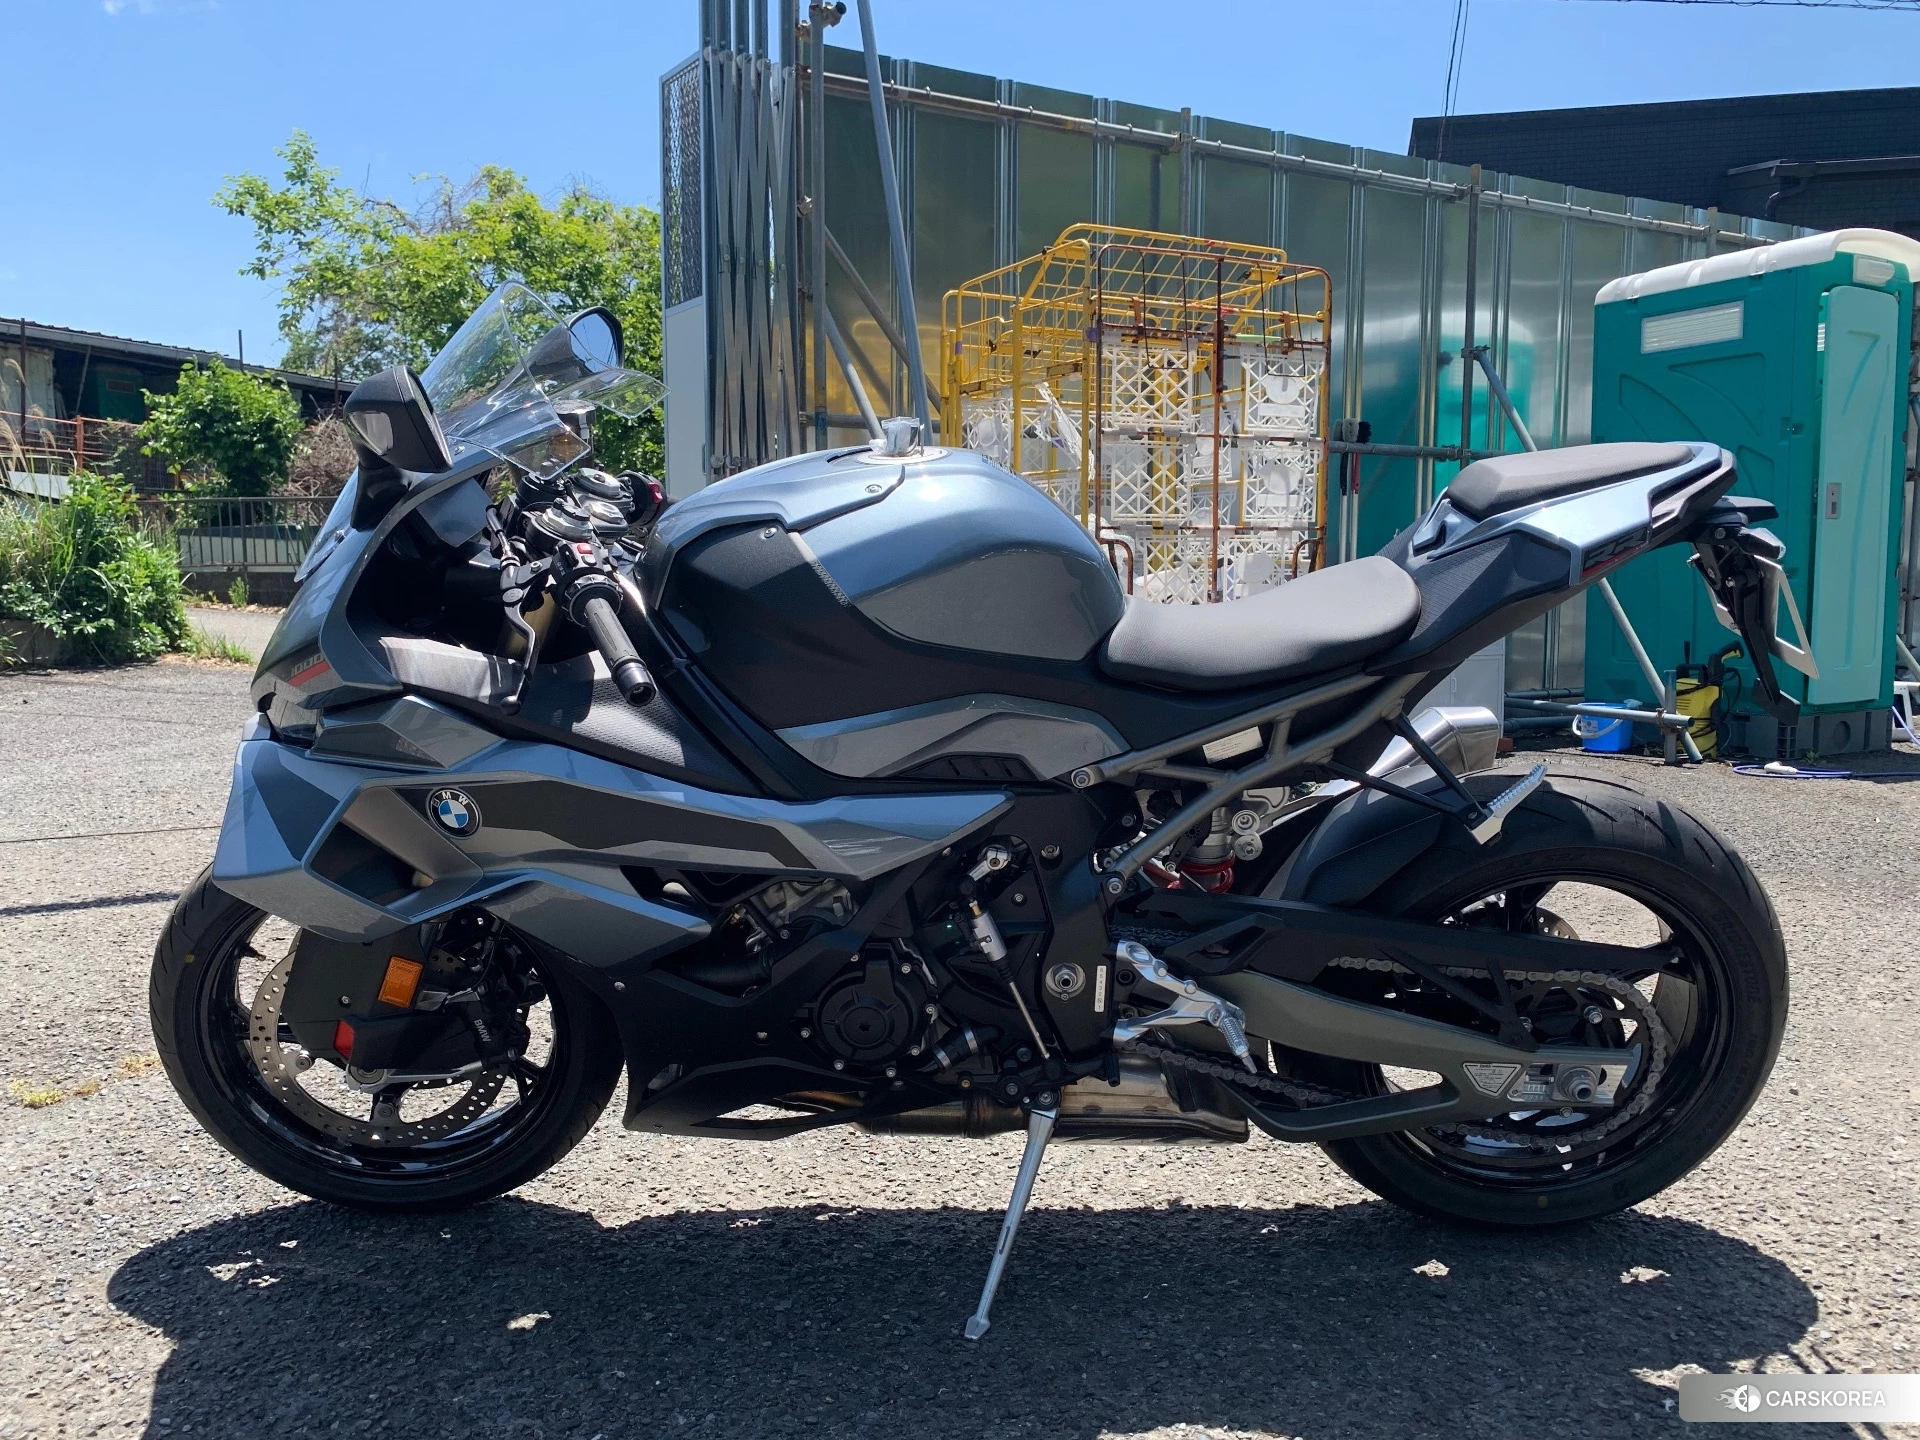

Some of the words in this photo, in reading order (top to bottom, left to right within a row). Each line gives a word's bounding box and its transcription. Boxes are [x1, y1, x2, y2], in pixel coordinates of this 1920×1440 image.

[1586, 526, 1646, 568] RR
[432, 791, 469, 808] BMW
[474, 1019, 491, 1042] BMW
